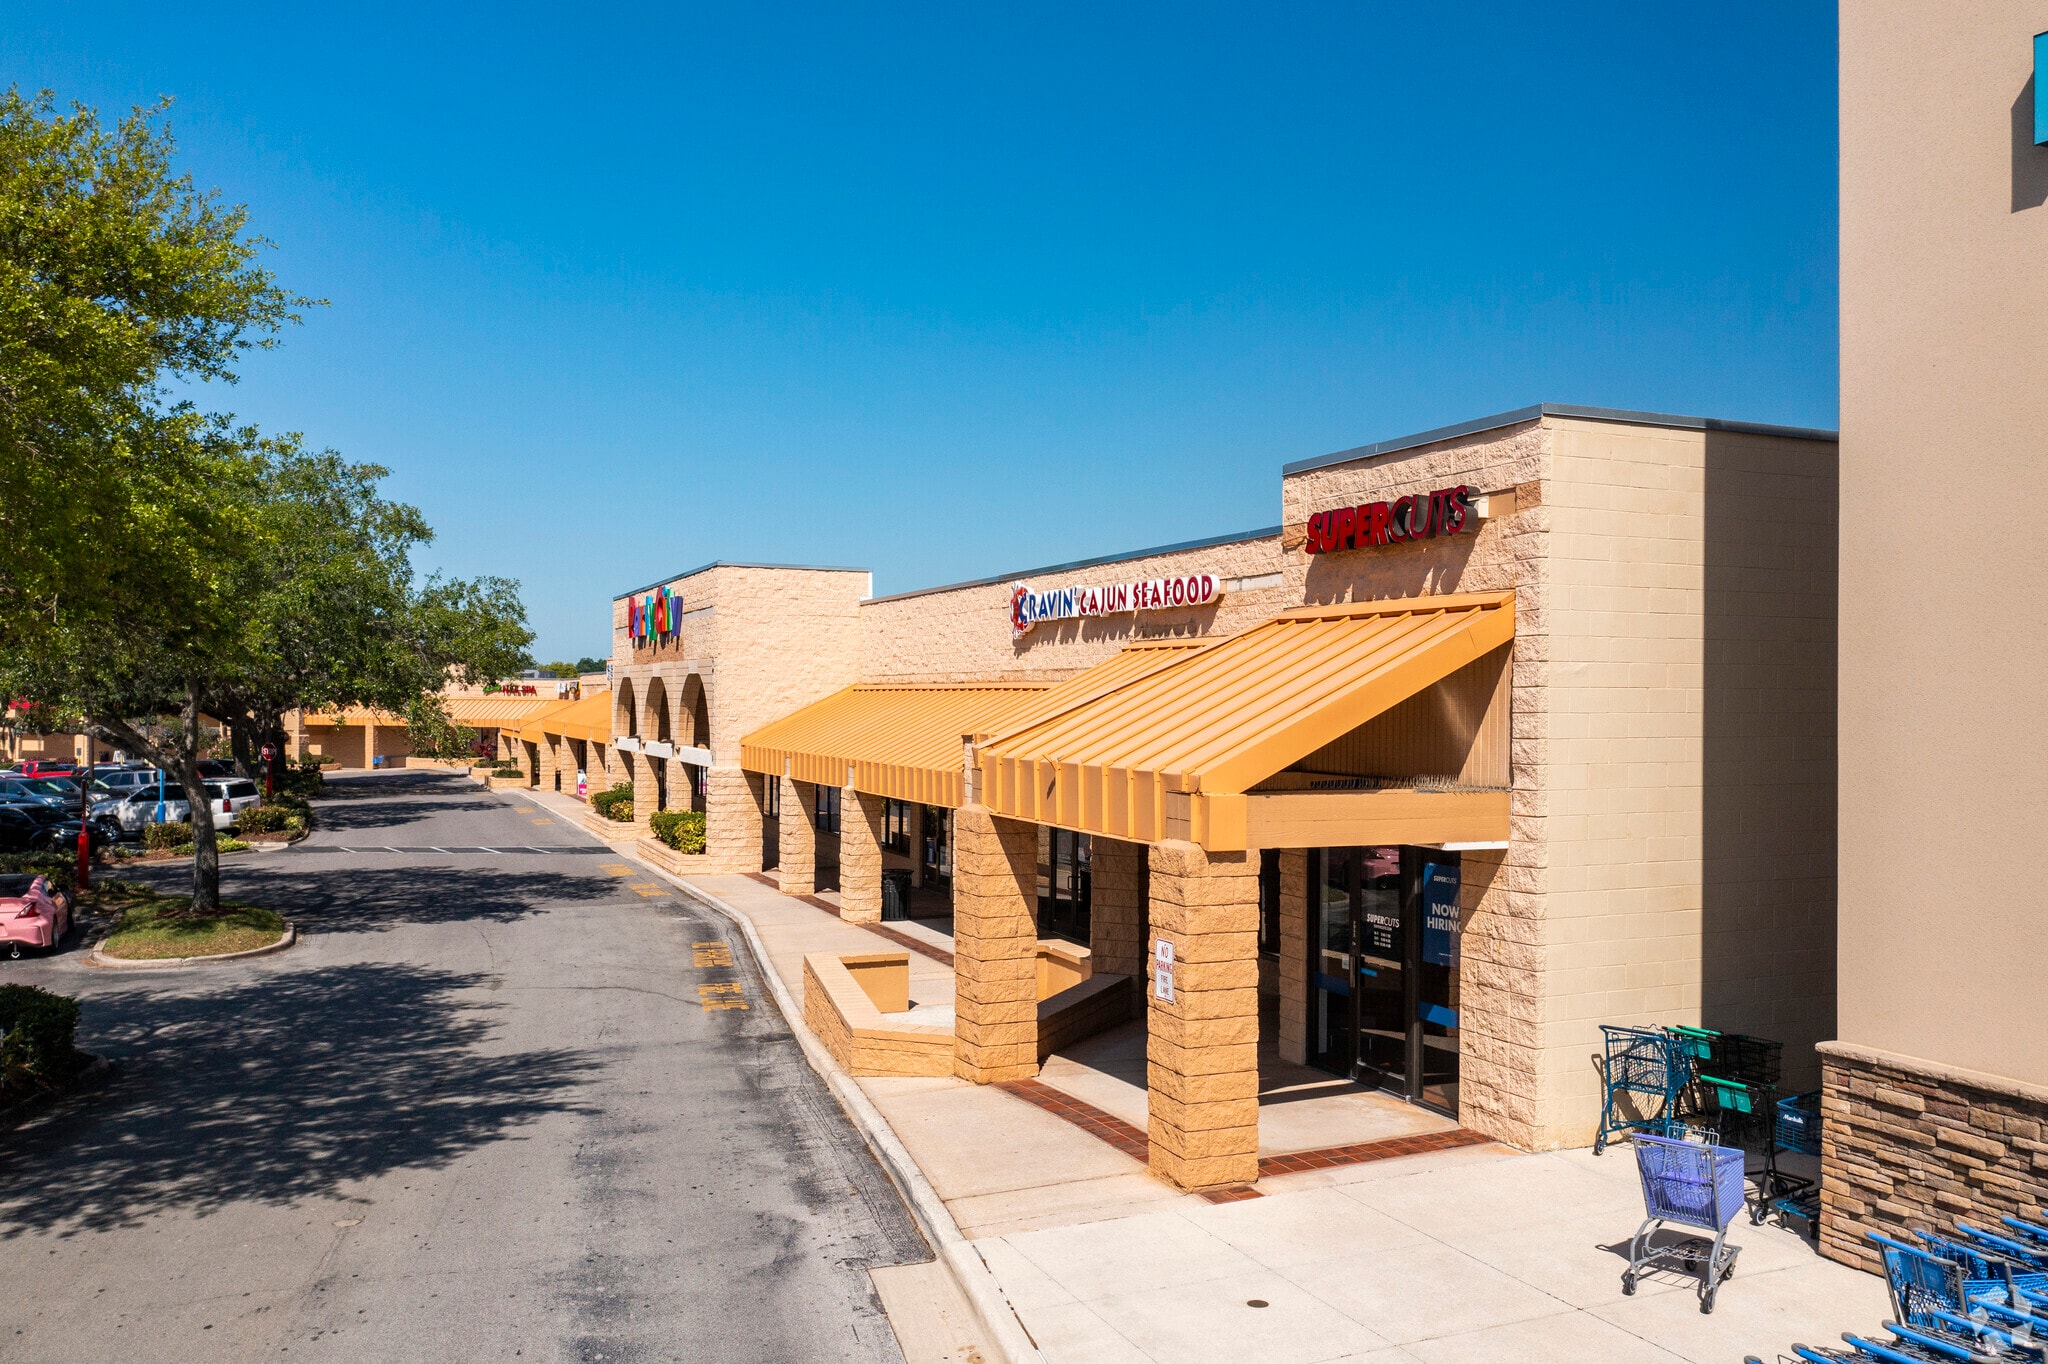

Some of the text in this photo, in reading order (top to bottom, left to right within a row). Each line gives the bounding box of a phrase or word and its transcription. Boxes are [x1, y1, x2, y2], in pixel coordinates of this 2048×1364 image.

[1305, 485, 1469, 554] SUPERCUTS
[1080, 584, 1127, 614] CAJUN
[1133, 575, 1213, 608] SEAFOOD
[1432, 903, 1460, 918] NOW
[1366, 913, 1400, 928] SUPERCUTS
[1161, 946, 1169, 958] NO
